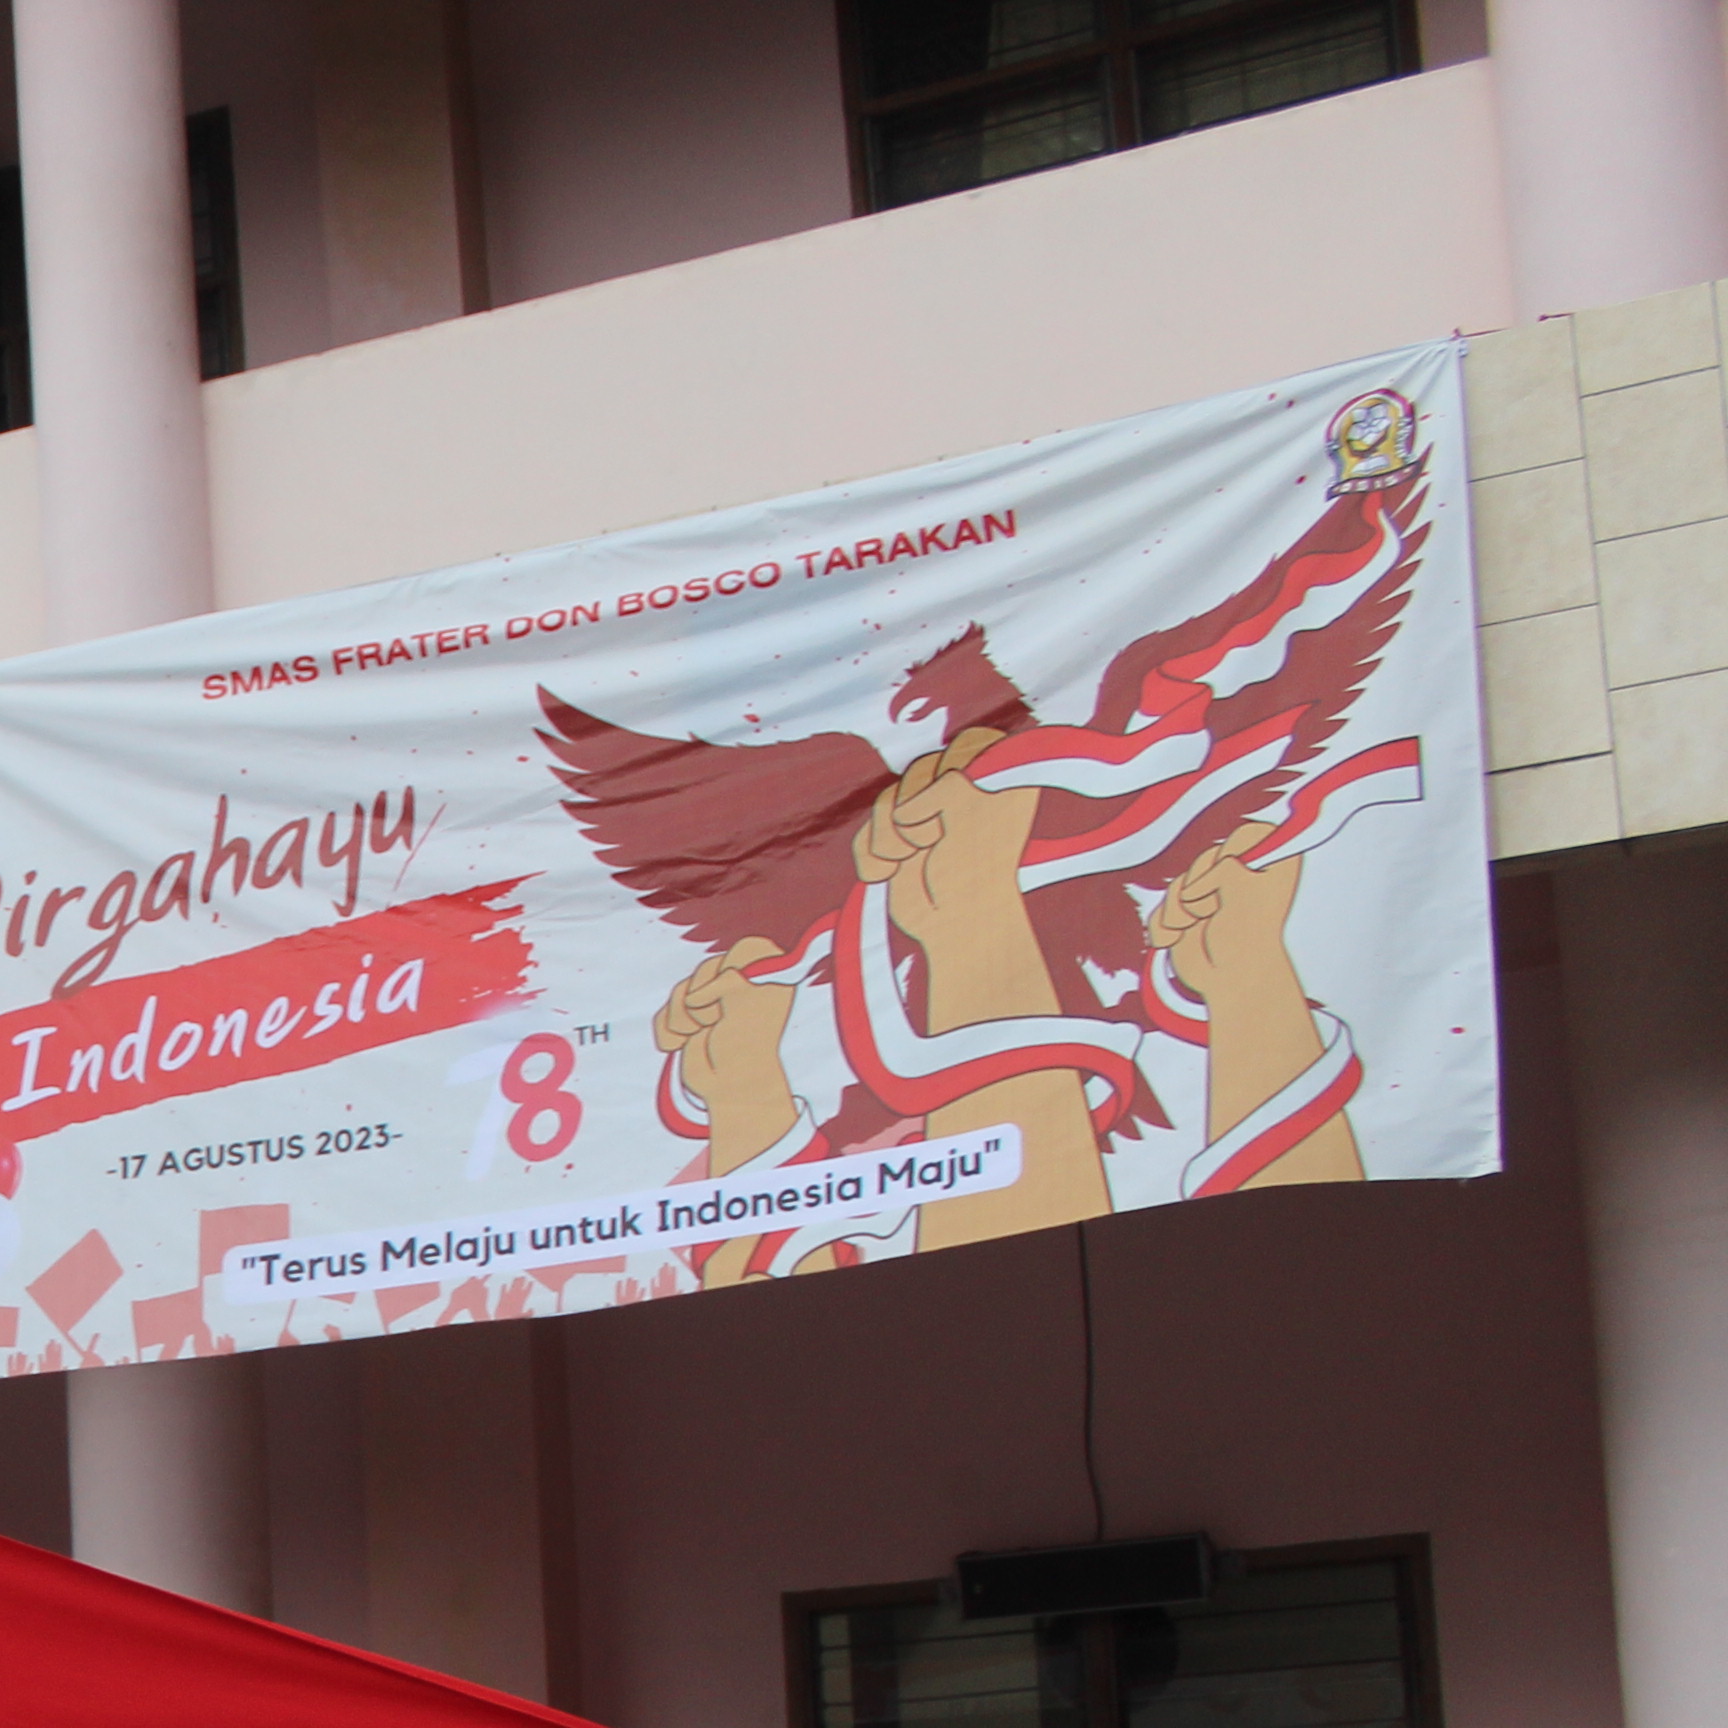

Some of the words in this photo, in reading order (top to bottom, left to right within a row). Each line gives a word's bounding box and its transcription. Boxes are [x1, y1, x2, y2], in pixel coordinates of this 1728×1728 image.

[202, 655, 320, 700] SMAS
[332, 623, 491, 676] FRATER
[505, 602, 600, 641] DON
[617, 562, 782, 618] BOSCO
[797, 509, 1017, 579] TARAKAN
[1, 954, 425, 1112] Indonesia
[106, 1154, 147, 1180] -17
[158, 1135, 305, 1176] AGUSTUS
[316, 1123, 404, 1156] 2023-
[241, 1253, 367, 1287] "Terus
[381, 1226, 515, 1271] Melaju
[529, 1206, 642, 1251] untuk
[656, 1173, 863, 1233] Indonesia
[878, 1138, 1001, 1194] Maju"
